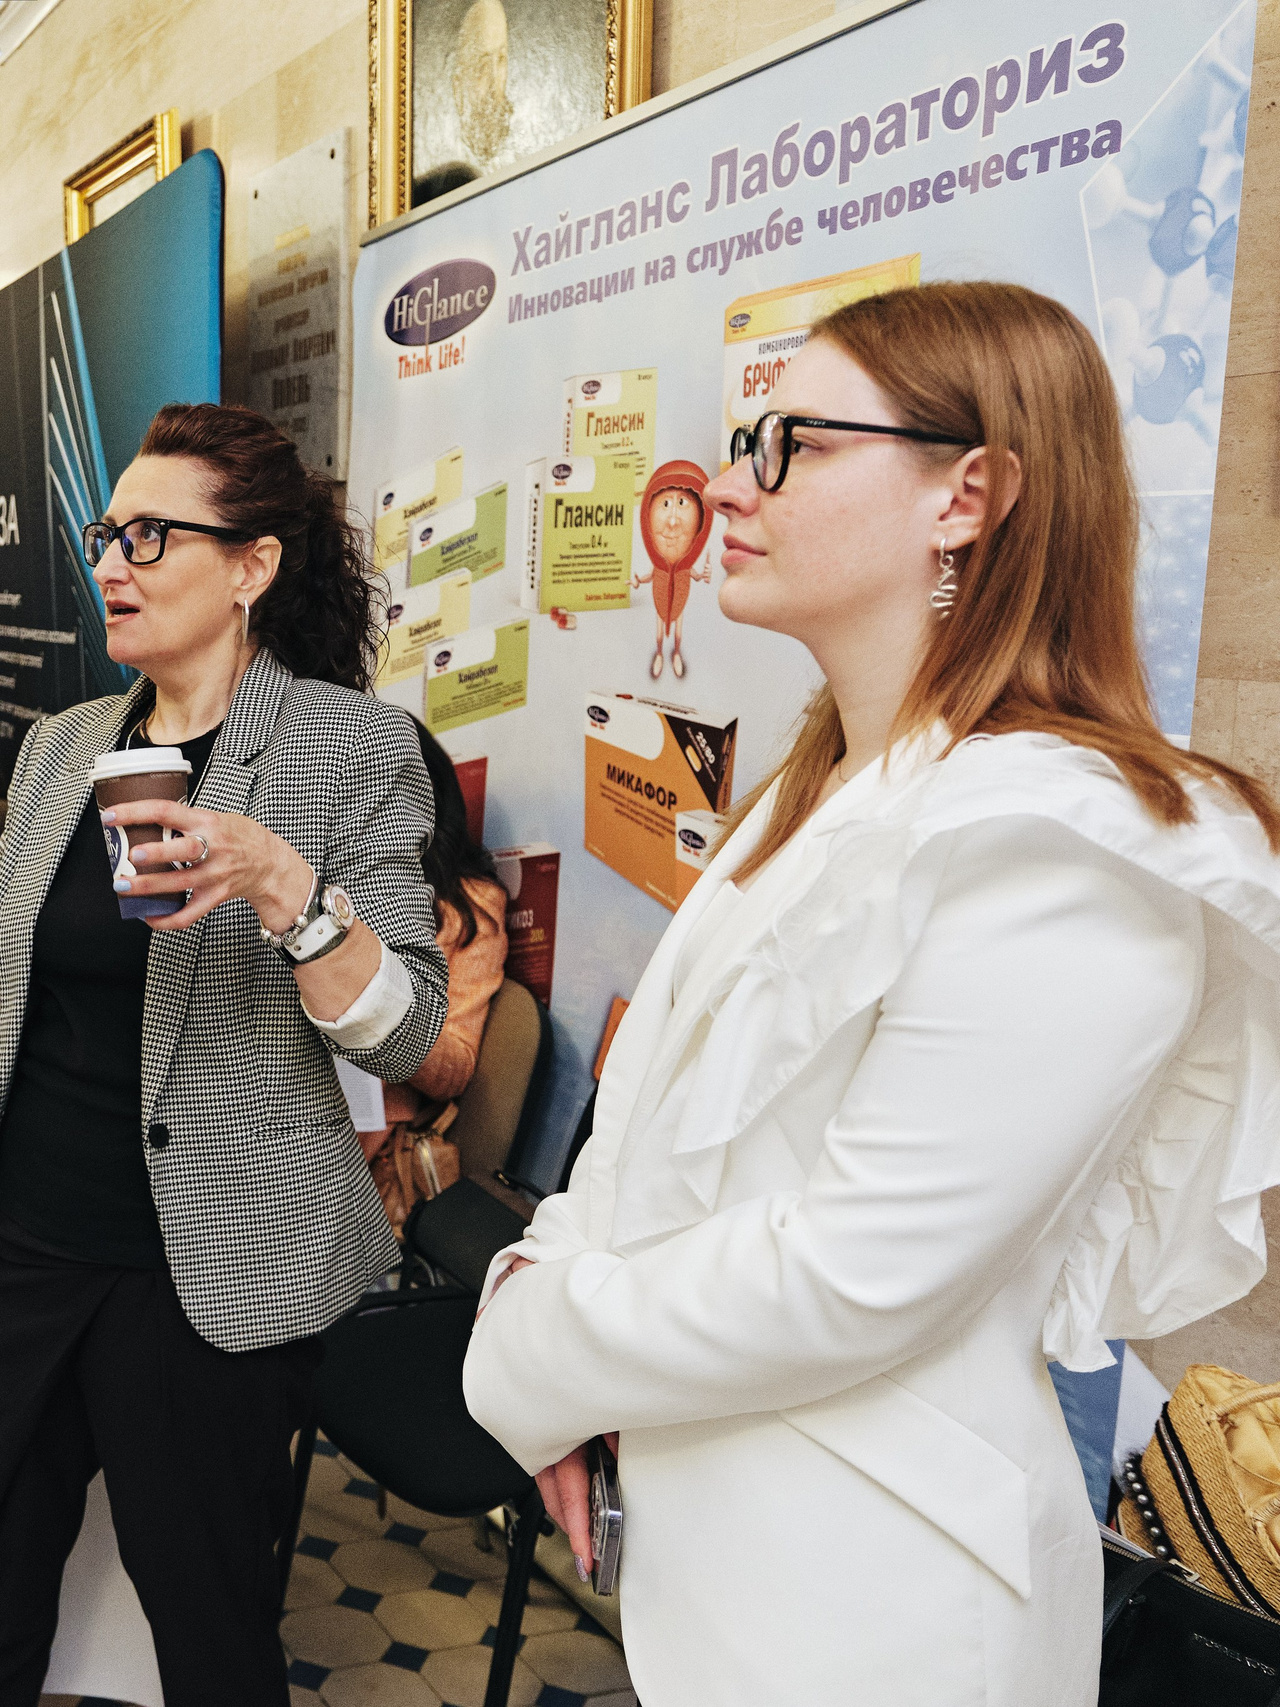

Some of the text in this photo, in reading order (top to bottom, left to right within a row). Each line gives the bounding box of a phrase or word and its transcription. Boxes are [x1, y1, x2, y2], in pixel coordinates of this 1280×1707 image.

[510, 22, 1126, 276] Хайгланс Лабораториз
[508, 119, 1123, 324] Инновации на службе человечества
[393, 278, 489, 337] HiGlance
[398, 335, 466, 379] Think Life!
[743, 356, 791, 398] БРУФ
[586, 411, 645, 437] Глансин
[554, 498, 625, 528] Глансин
[606, 763, 678, 811] МИКАФОР
